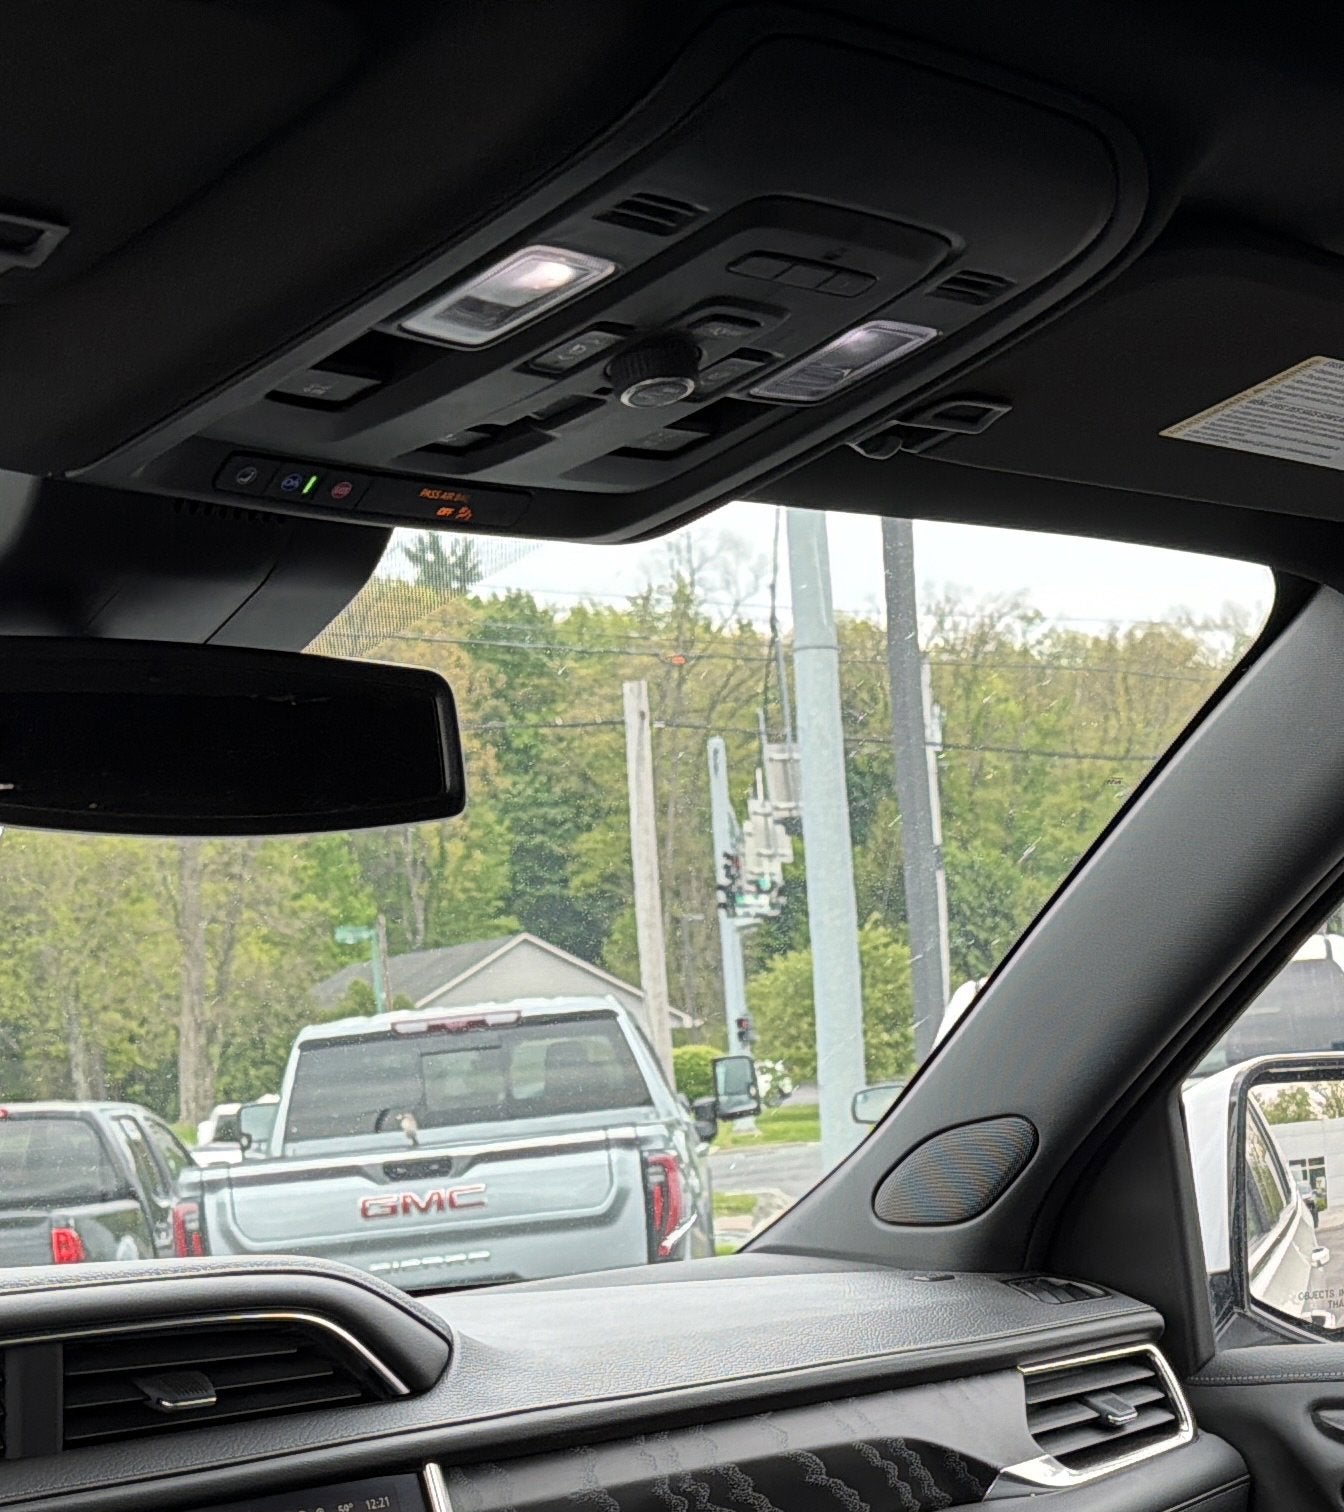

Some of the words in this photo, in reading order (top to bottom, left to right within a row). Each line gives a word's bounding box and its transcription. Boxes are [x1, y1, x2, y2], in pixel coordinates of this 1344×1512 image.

[359, 1183, 488, 1220] GMC
[1298, 1289, 1335, 1301] OBJECTS
[365, 1496, 391, 1511] 12:21
